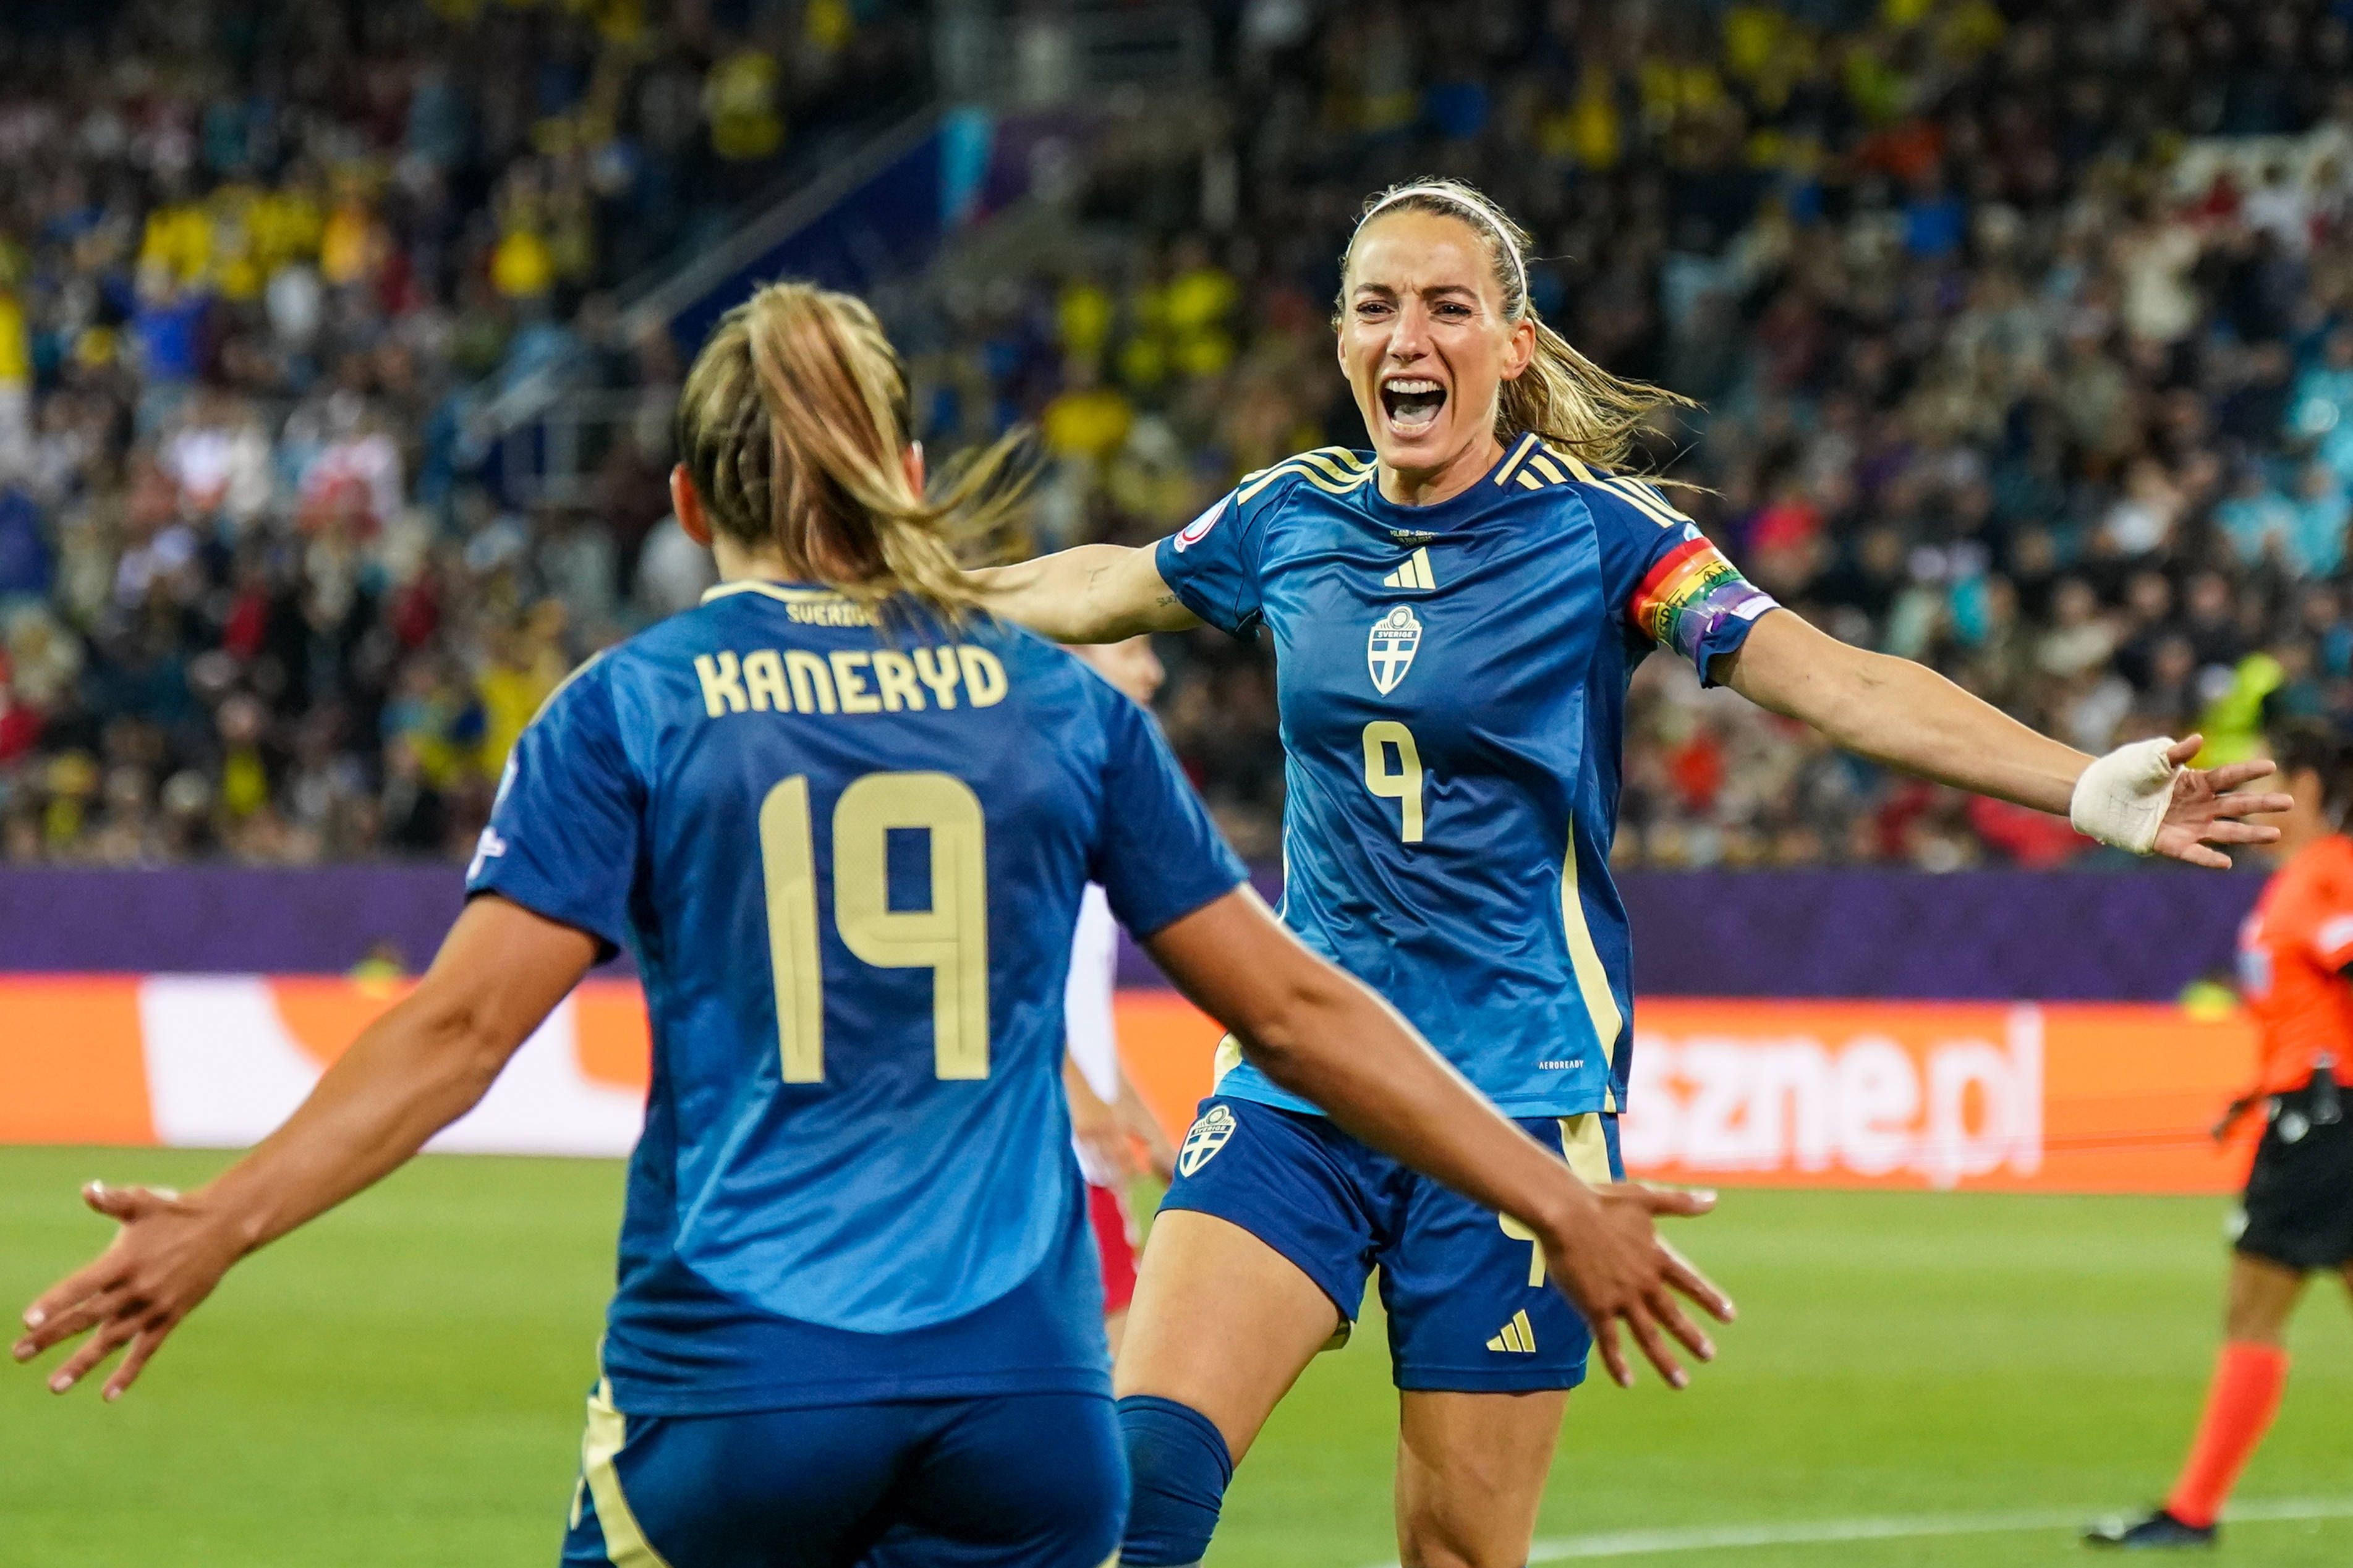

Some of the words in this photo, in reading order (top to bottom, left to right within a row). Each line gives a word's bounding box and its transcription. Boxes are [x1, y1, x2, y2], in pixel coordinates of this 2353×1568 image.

[694, 645, 1008, 717] KANERYD
[1363, 721, 1423, 842] 9
[759, 770, 989, 1083] 19
[1539, 1060, 1584, 1070] AEROREADY
